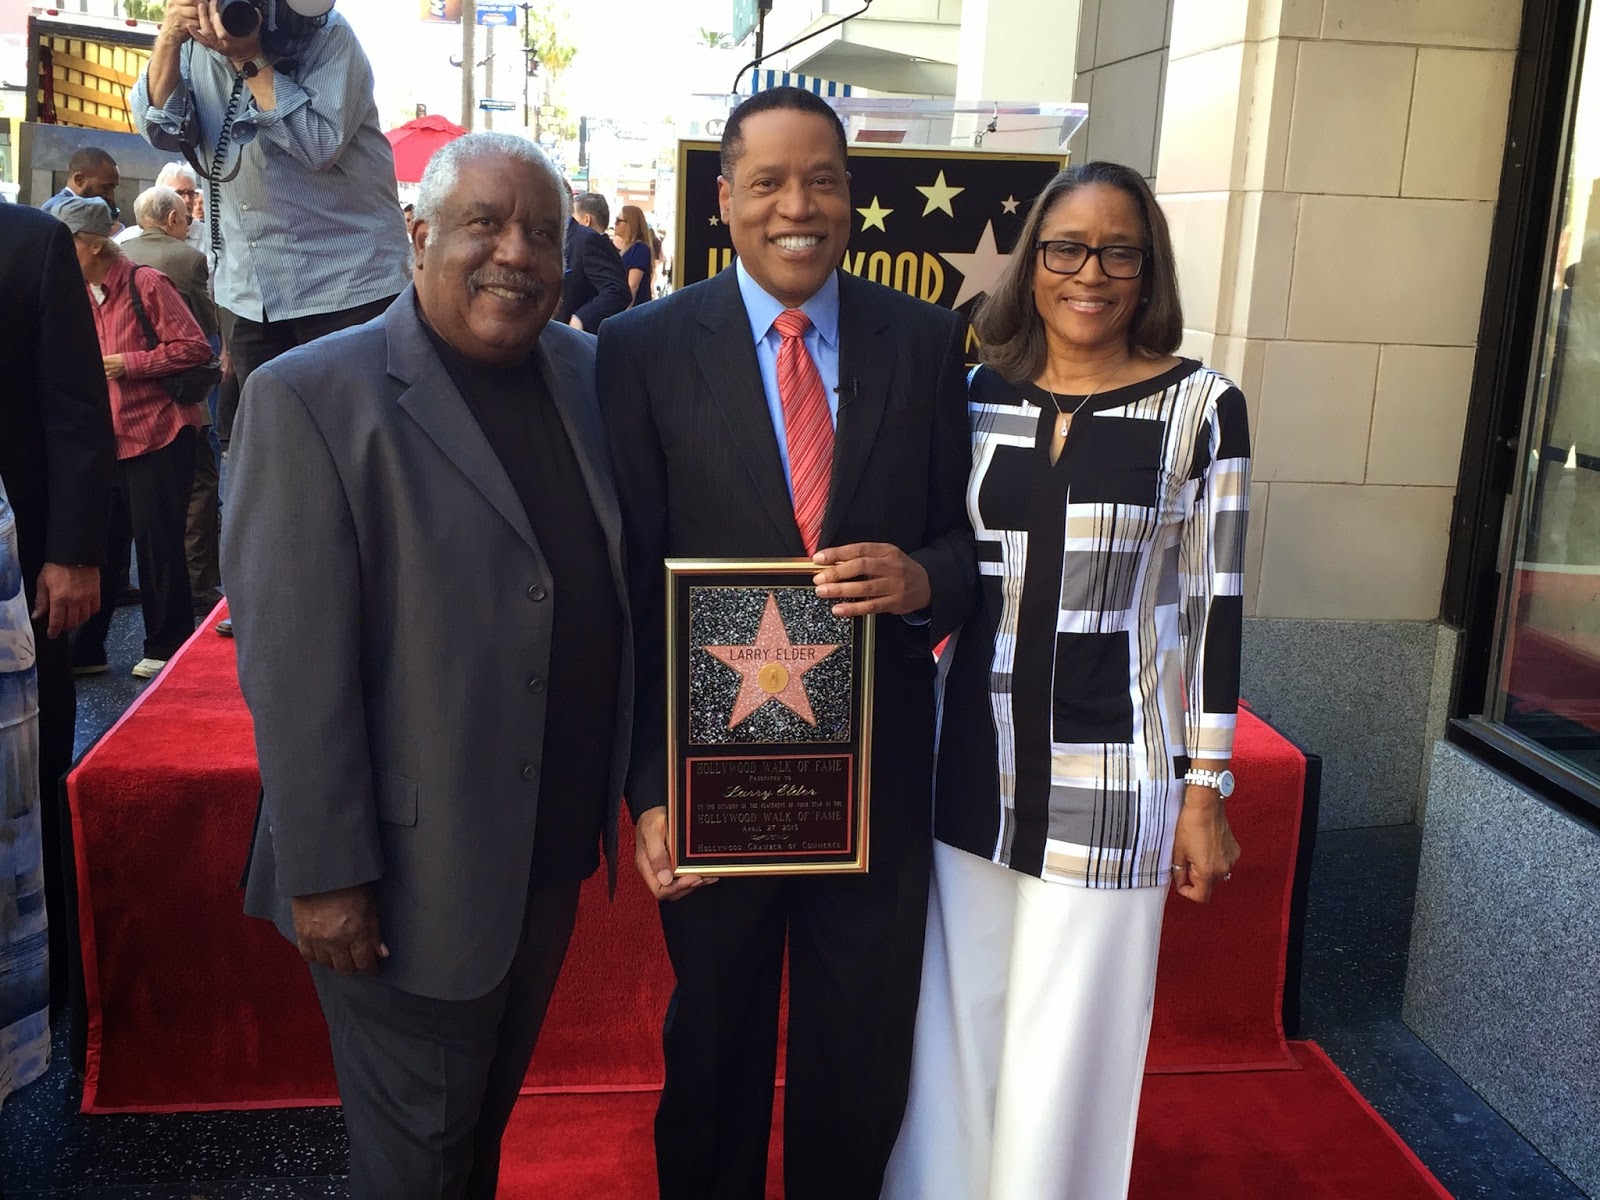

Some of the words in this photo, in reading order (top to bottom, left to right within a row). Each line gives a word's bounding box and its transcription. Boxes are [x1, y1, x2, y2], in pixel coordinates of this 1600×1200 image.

[730, 648, 770, 661] LARRY
[776, 648, 816, 660] ELDER
[697, 761, 757, 775] HOLLYWOOD
[763, 761, 792, 773] WALK
[797, 760, 810, 773] OF
[815, 760, 842, 772] FAME
[723, 785, 773, 800] Larry
[776, 783, 818, 796] Elder
[697, 813, 757, 824] HOLLYWOOD
[763, 812, 792, 822] WALK
[797, 811, 810, 822] OF
[815, 811, 842, 821] FAME
[766, 824, 777, 832] 27
